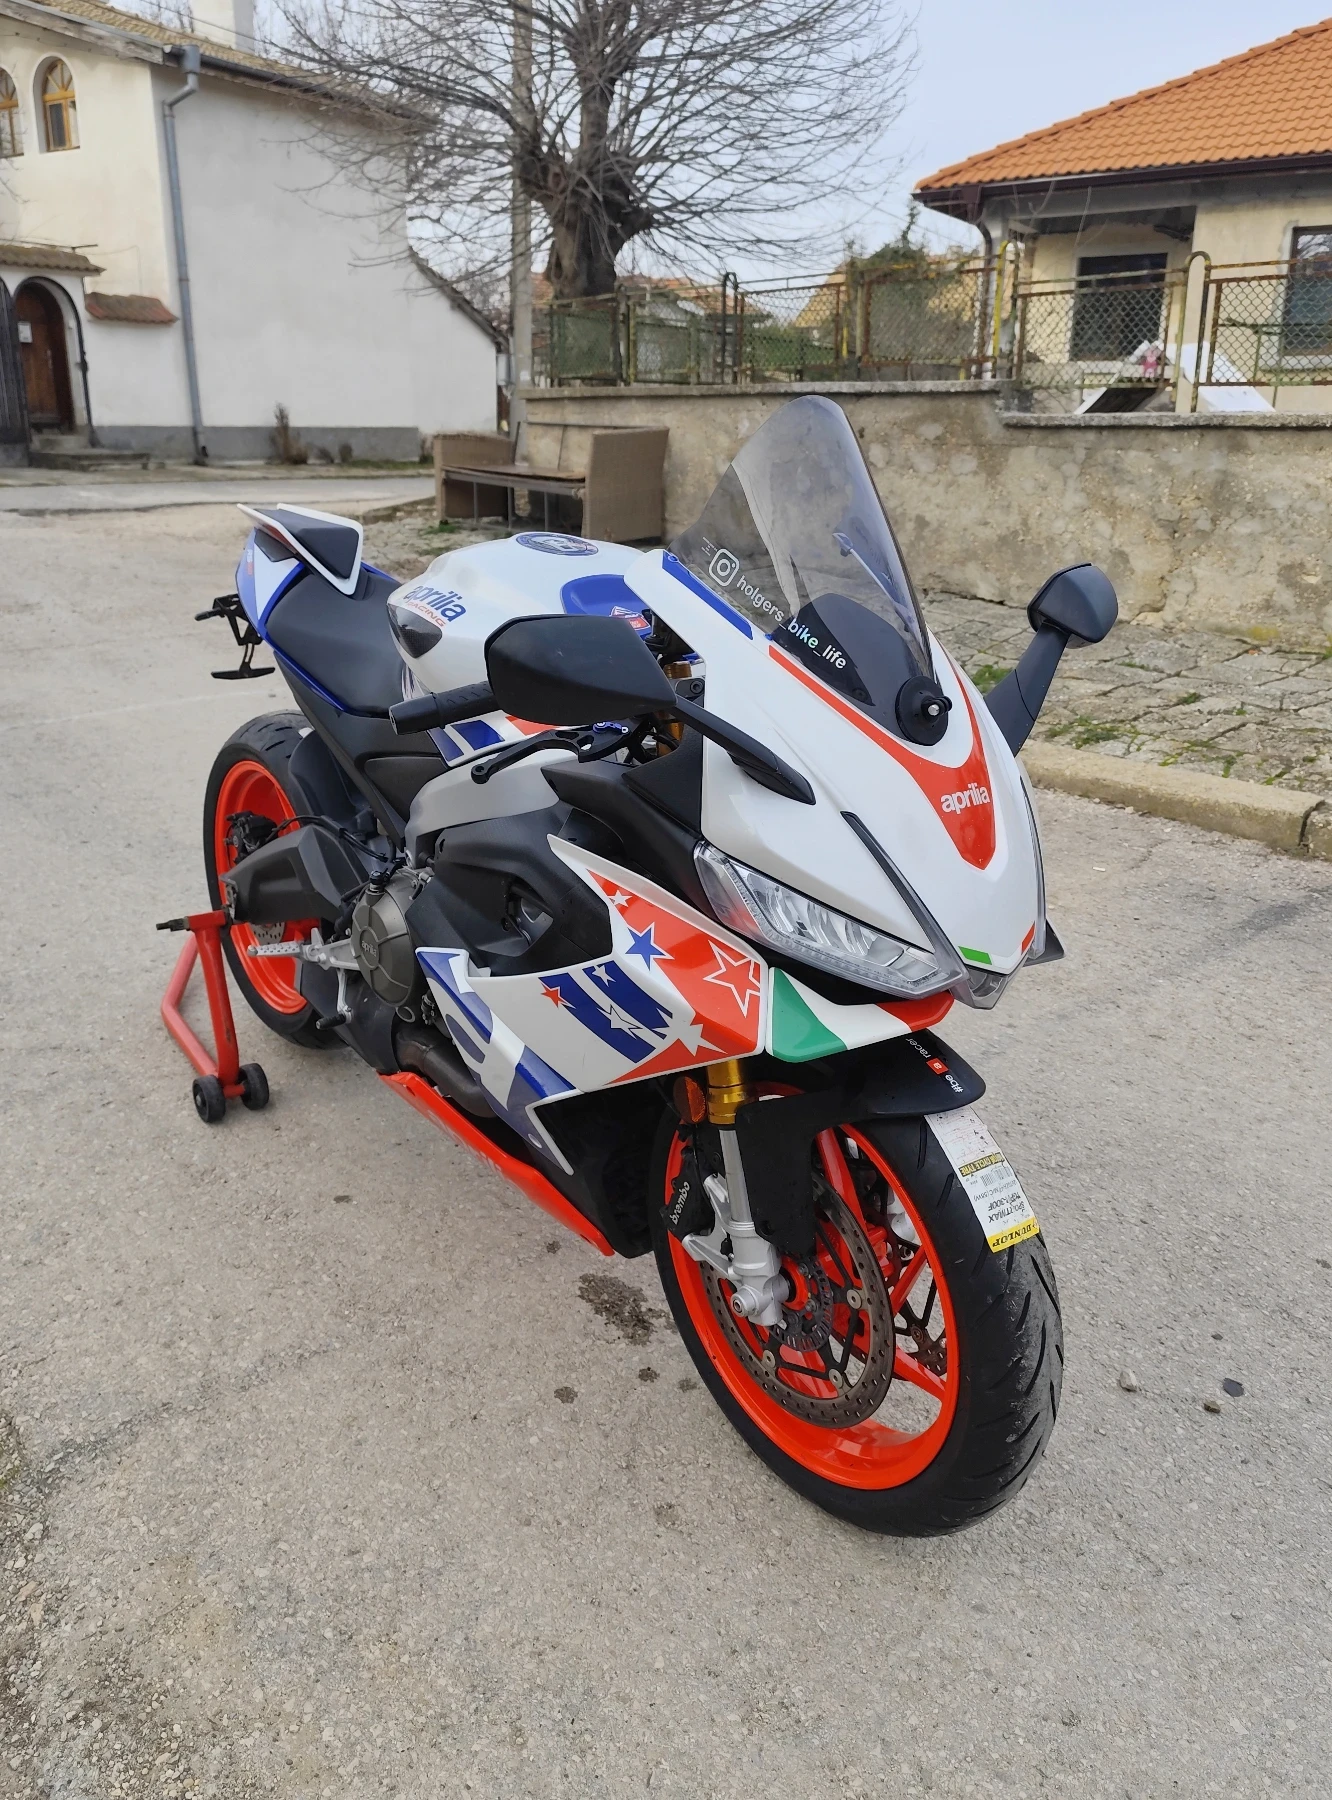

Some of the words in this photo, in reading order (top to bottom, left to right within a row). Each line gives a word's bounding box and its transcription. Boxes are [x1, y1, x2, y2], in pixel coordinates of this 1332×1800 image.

[403, 585, 467, 623] aprilia
[408, 601, 446, 627] RACING
[736, 575, 847, 669] holgers_bike_life
[940, 782, 991, 815] aprilia
[905, 1038, 931, 1058] racer
[945, 1074, 964, 1093] #be
[669, 1181, 690, 1225] brembo
[992, 1223, 1032, 1247] DUNLOP
